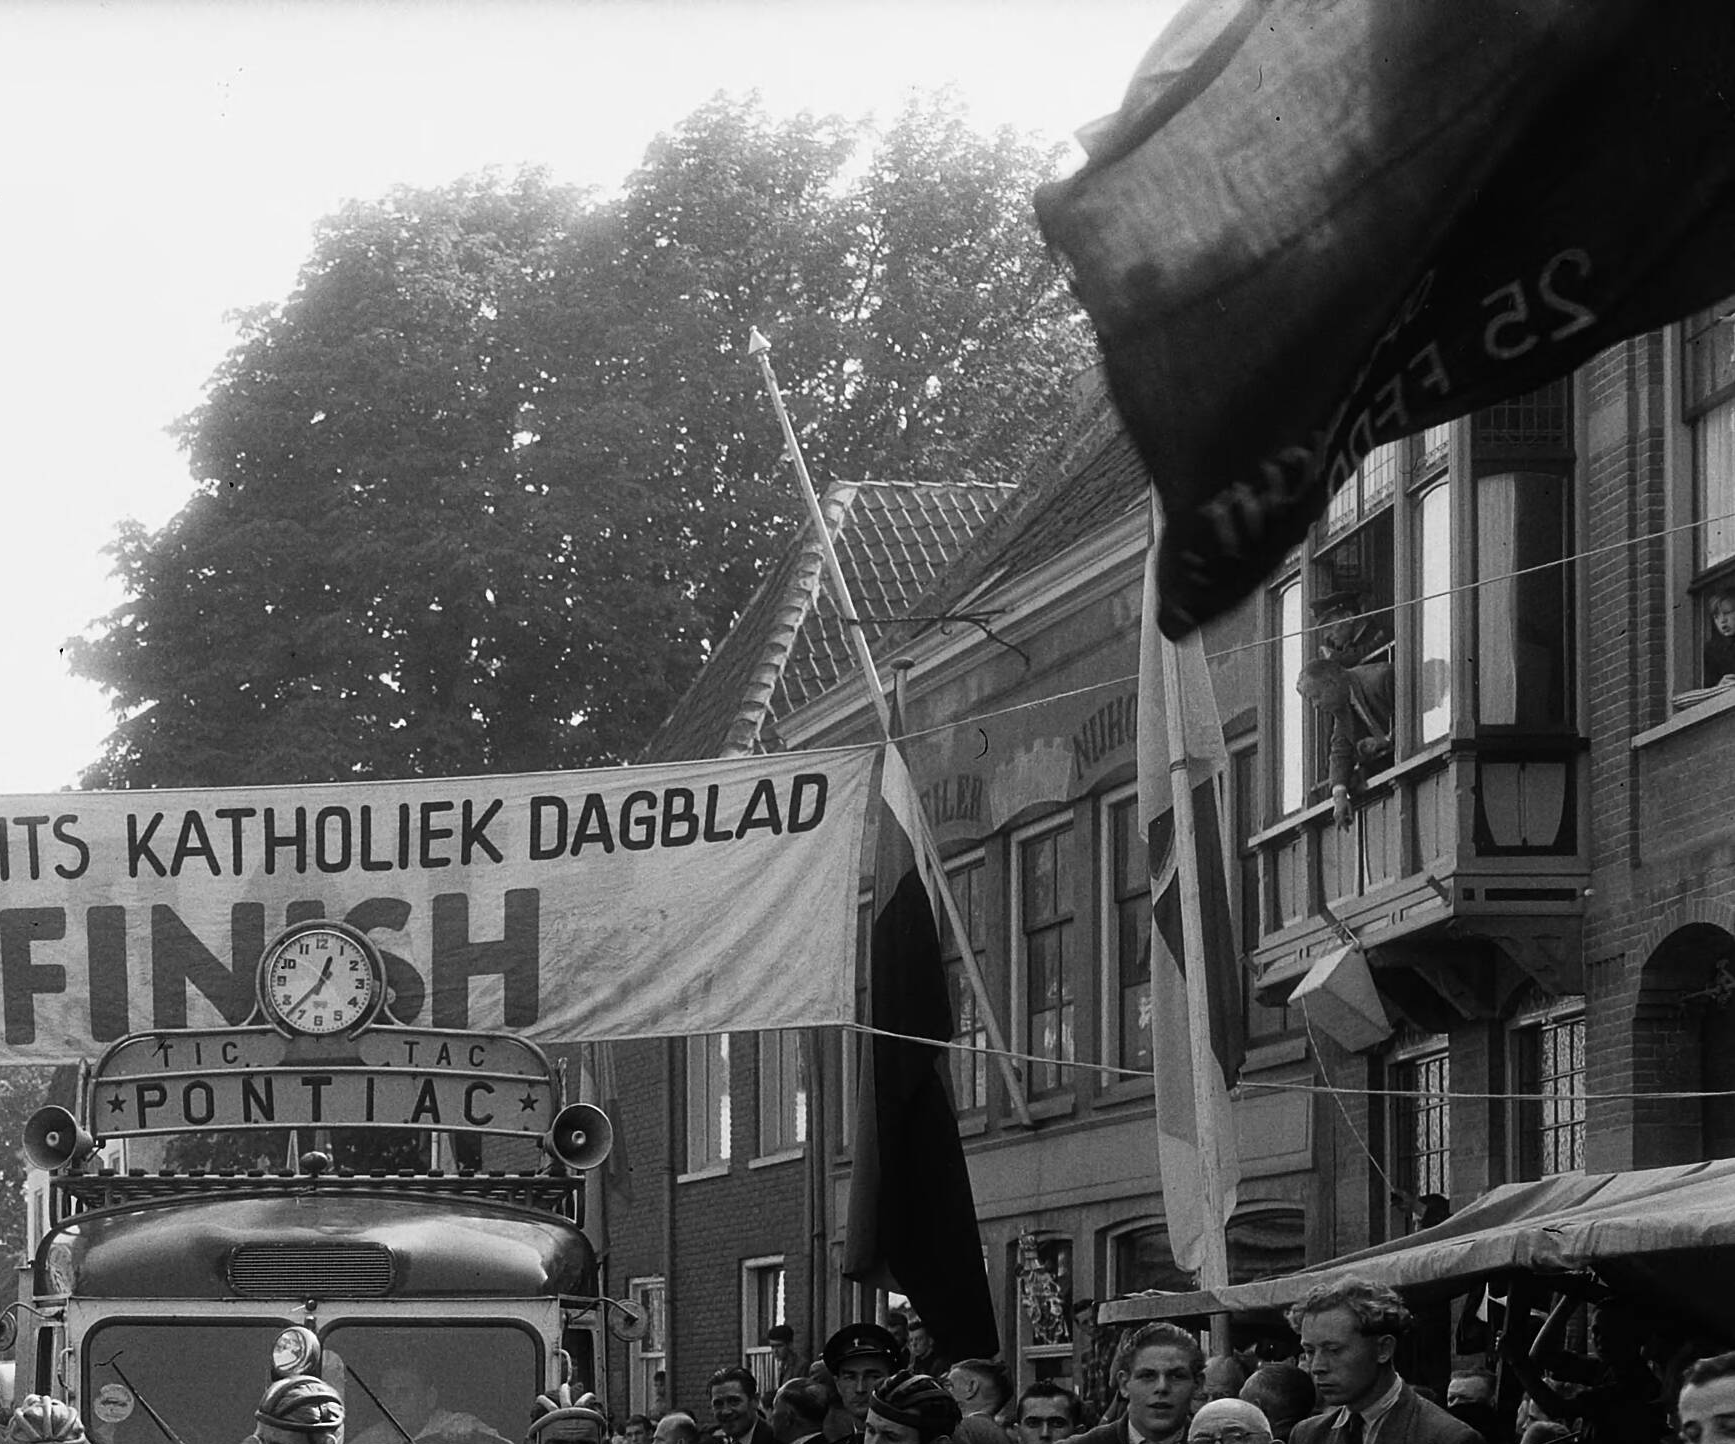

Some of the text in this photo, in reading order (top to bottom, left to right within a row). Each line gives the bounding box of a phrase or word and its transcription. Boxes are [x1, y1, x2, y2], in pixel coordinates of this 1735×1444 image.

[127, 798, 504, 878] KATHOLIEK
[529, 773, 829, 861] DAGBLAD
[299, 943, 309, 955] 11
[315, 939, 329, 950] 12
[339, 945, 344, 956] 1
[0, 887, 540, 1046] FINSH
[280, 958, 296, 969] 10
[349, 960, 359, 971] 2
[277, 975, 287, 987] 9
[355, 978, 364, 990] 3
[282, 994, 292, 1006] 8
[347, 996, 359, 1008] 4
[297, 1009, 307, 1021] 7
[314, 1016, 323, 1026] 6
[333, 1010, 343, 1021] 5
[158, 1040, 486, 1067] TIC TAC
[136, 1076, 496, 1128] PONTIAC
